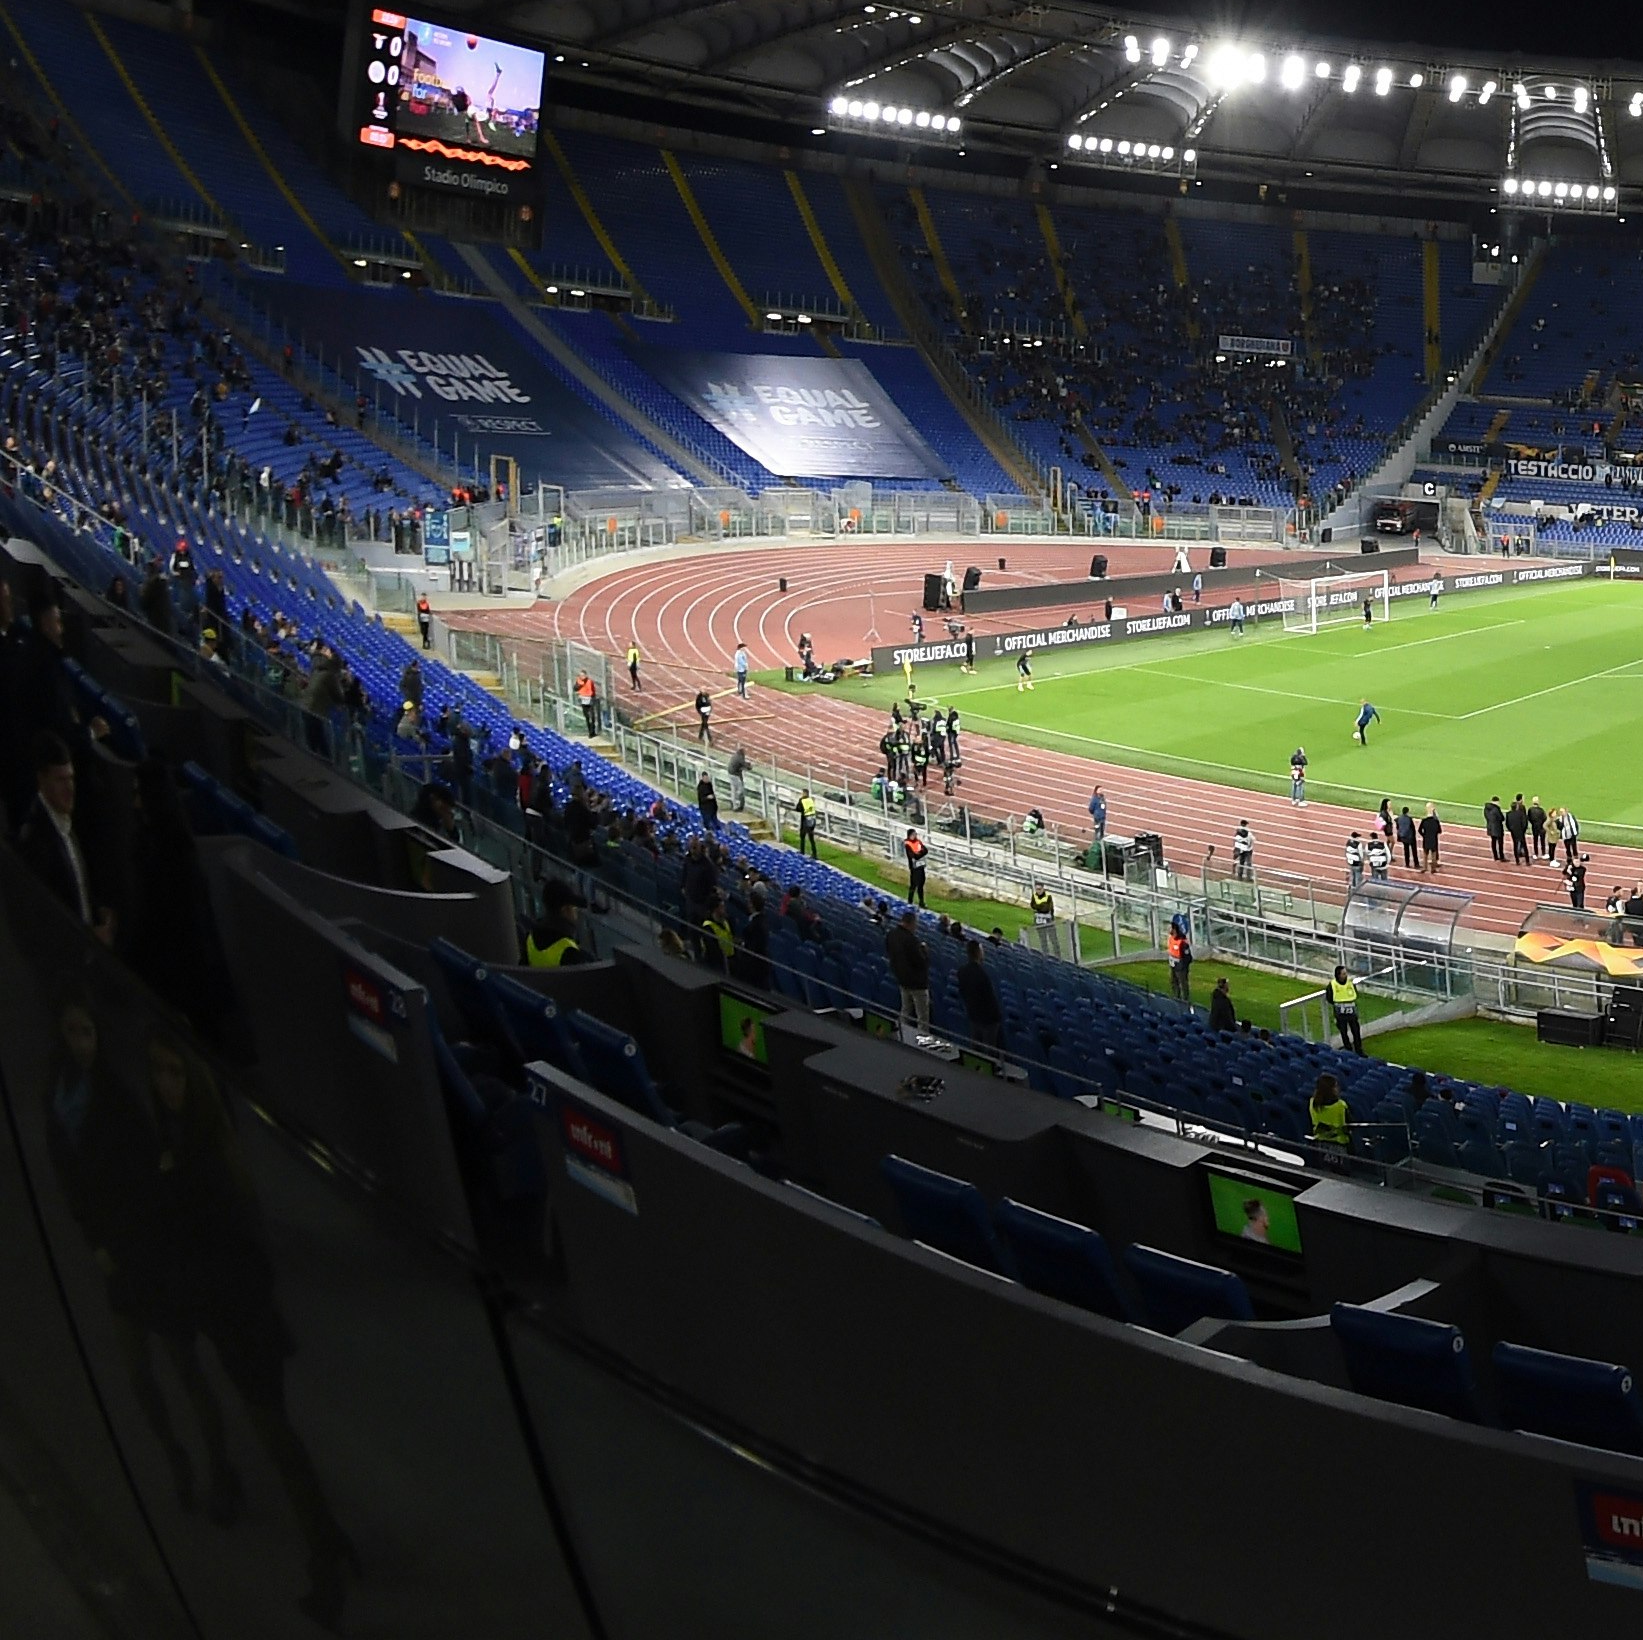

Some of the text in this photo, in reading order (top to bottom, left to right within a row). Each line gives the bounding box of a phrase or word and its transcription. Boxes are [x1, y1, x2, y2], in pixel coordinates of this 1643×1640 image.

[424, 166, 509, 195] Stadio Olimpico
[425, 375, 531, 404] GAME
[769, 406, 881, 429] GAME
[1508, 459, 1593, 480] TESTACCIO
[1424, 482, 1435, 496] C
[1004, 623, 1111, 653] OFFICIAL MERCHANDISE
[1126, 614, 1191, 636] STORE.UEFA.COM
[527, 1076, 547, 1107] 27
